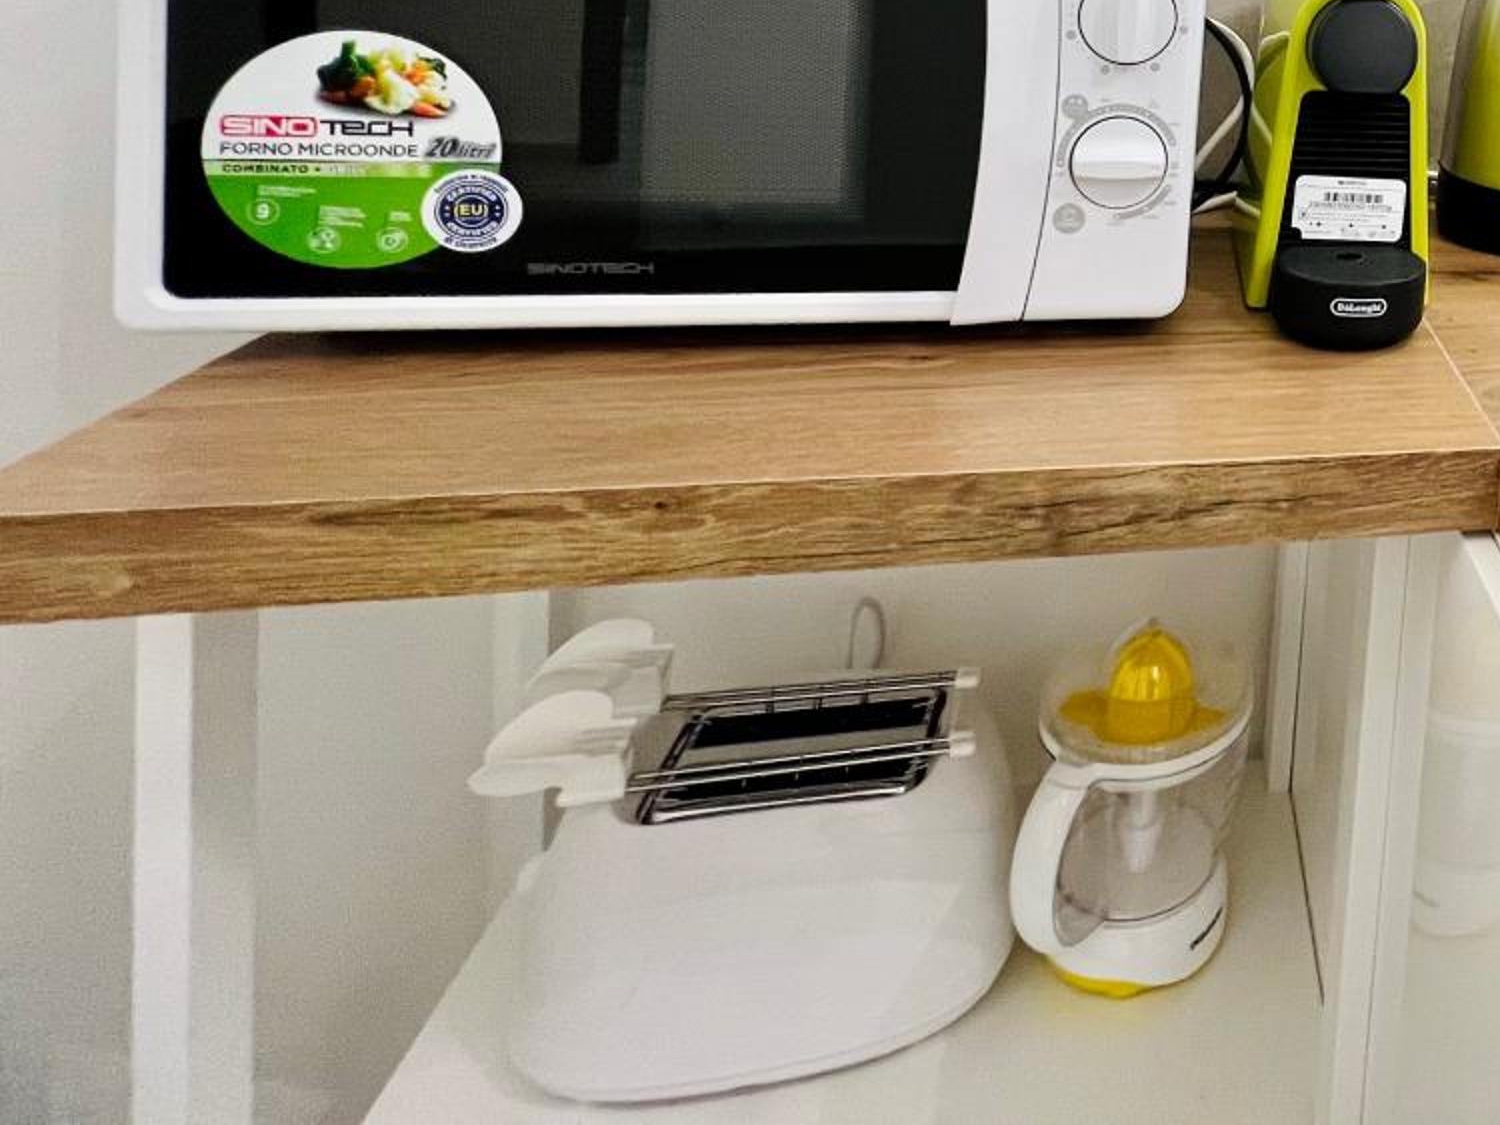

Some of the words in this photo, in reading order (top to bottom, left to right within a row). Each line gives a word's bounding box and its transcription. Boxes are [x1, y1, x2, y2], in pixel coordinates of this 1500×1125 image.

[219, 142, 292, 156] FORNO
[297, 143, 418, 157] MICROONDE
[222, 163, 309, 174] COMBINATO
